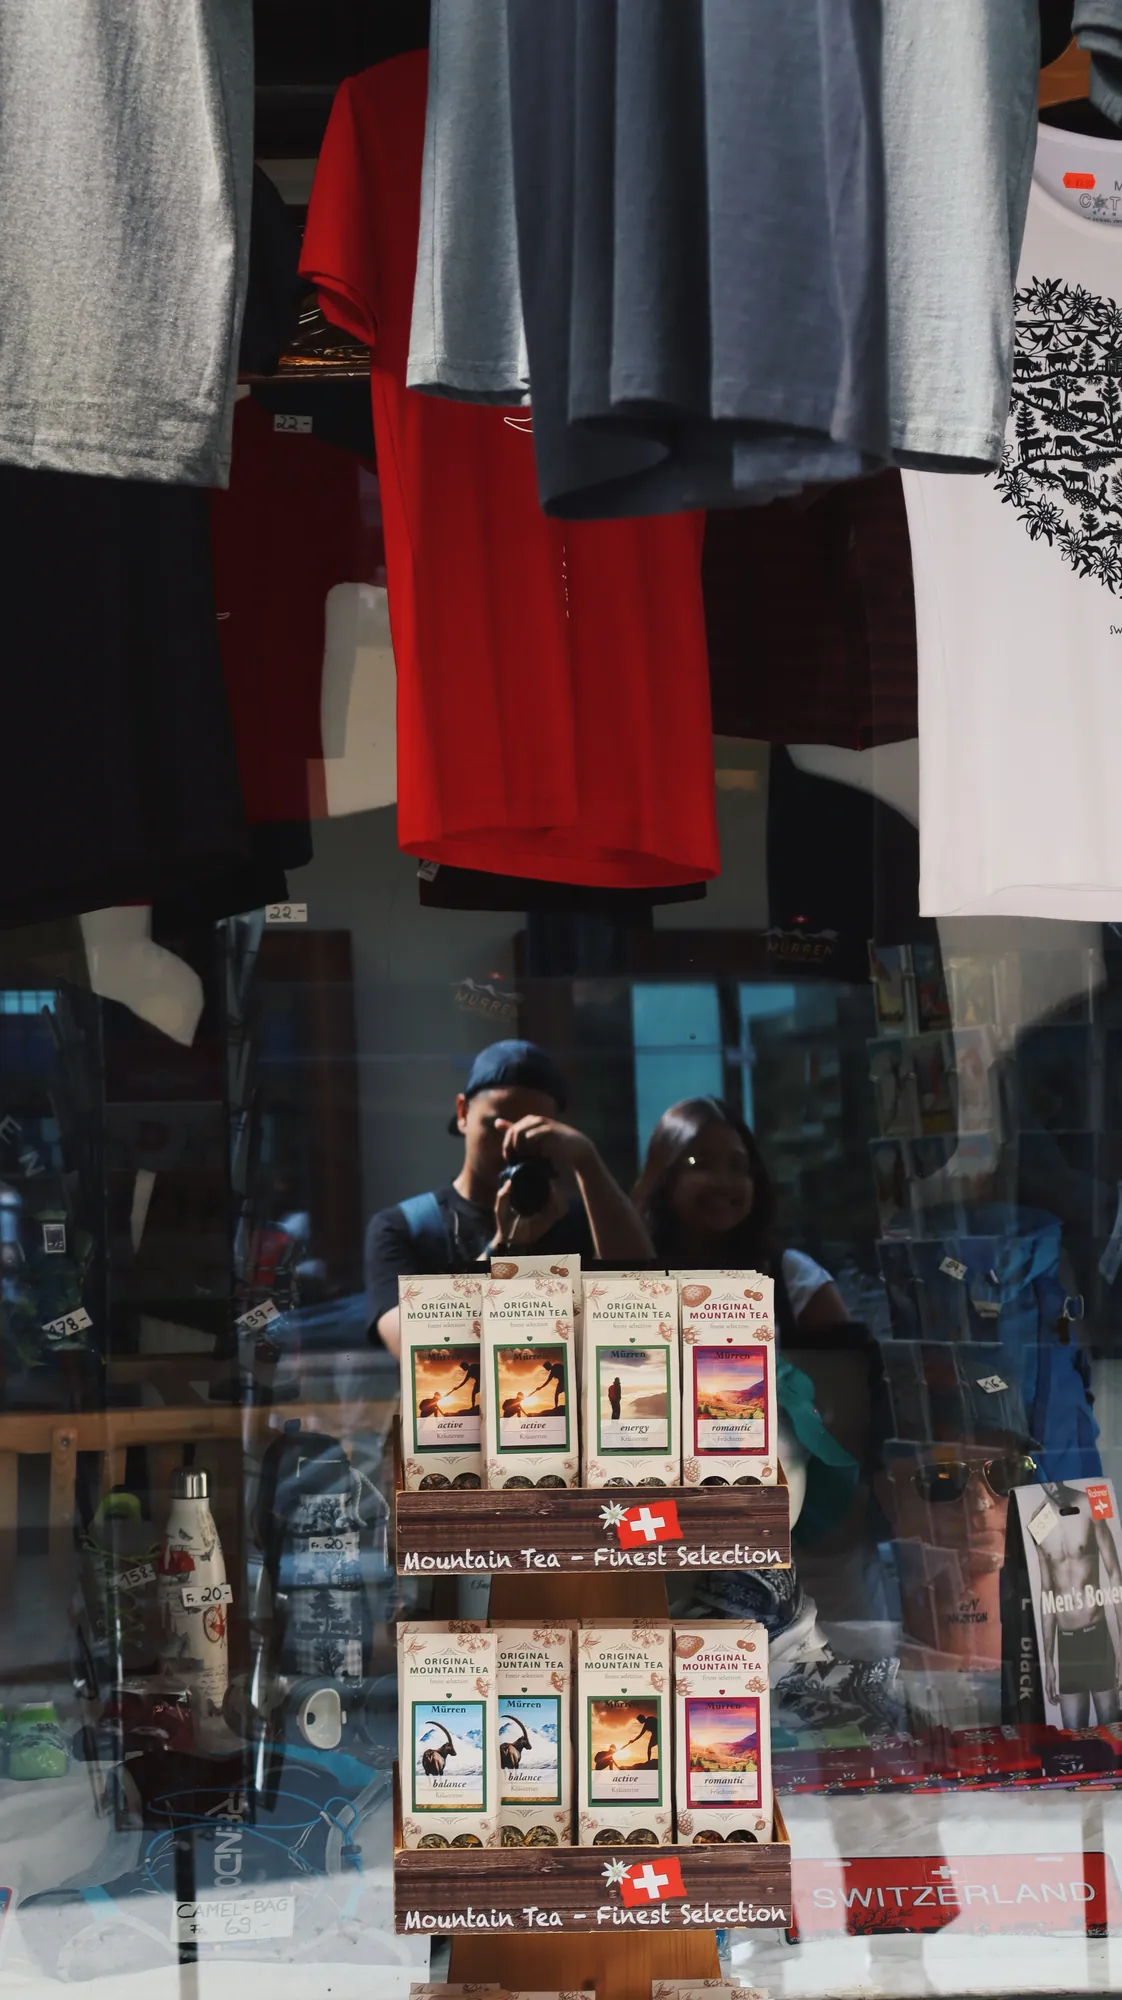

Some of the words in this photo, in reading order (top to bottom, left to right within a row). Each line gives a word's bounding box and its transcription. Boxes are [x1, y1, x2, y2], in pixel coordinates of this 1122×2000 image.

[421, 1302, 471, 1310] ORIGINAL
[503, 1301, 554, 1309] ORIGINAL
[606, 1302, 657, 1310] ORIGINAL
[704, 1303, 754, 1311] ORIGINAL
[407, 1311, 462, 1319] MOUNTAIN
[489, 1310, 545, 1319] MOUNTAIN
[549, 1309, 568, 1317] TEA
[652, 1311, 671, 1319] TEA
[611, 1350, 646, 1358] Mürren
[437, 1421, 463, 1429] active
[520, 1421, 546, 1429] active
[620, 1424, 649, 1434] energy
[711, 1424, 752, 1432] romantic
[404, 1548, 512, 1571] Mountain
[520, 1548, 561, 1569] Tea
[594, 1545, 669, 1567] Finest
[677, 1544, 783, 1567] Selection
[201, 1587, 230, 1603] 20.-
[1041, 1587, 1084, 1615] Men's
[500, 1652, 550, 1660] ORIGINAL
[599, 1653, 649, 1661] ORIGINAL
[696, 1654, 747, 1662] ORIGINAL
[424, 1658, 474, 1666] ORIGINAL
[497, 1661, 541, 1669] OUNTAIN
[545, 1661, 564, 1669] TEA
[644, 1661, 663, 1669] TEA
[410, 1667, 466, 1675] MOUNTAIN
[470, 1666, 489, 1674] TEA
[682, 1663, 738, 1671] MOUNTAIN
[506, 1700, 541, 1708] Mürren
[431, 1705, 466, 1713] Mürren
[508, 1772, 542, 1782] balance
[612, 1774, 639, 1782] active
[704, 1777, 745, 1785] romantic
[432, 1779, 467, 1788] balance
[812, 1881, 1096, 1909] SWITZERLAND
[176, 1898, 288, 1919] CAMEL-BAG
[404, 1907, 514, 1931] Mountain
[522, 1906, 564, 1928] Tea
[596, 1902, 671, 1925] Finest
[680, 1901, 787, 1925] Selection
